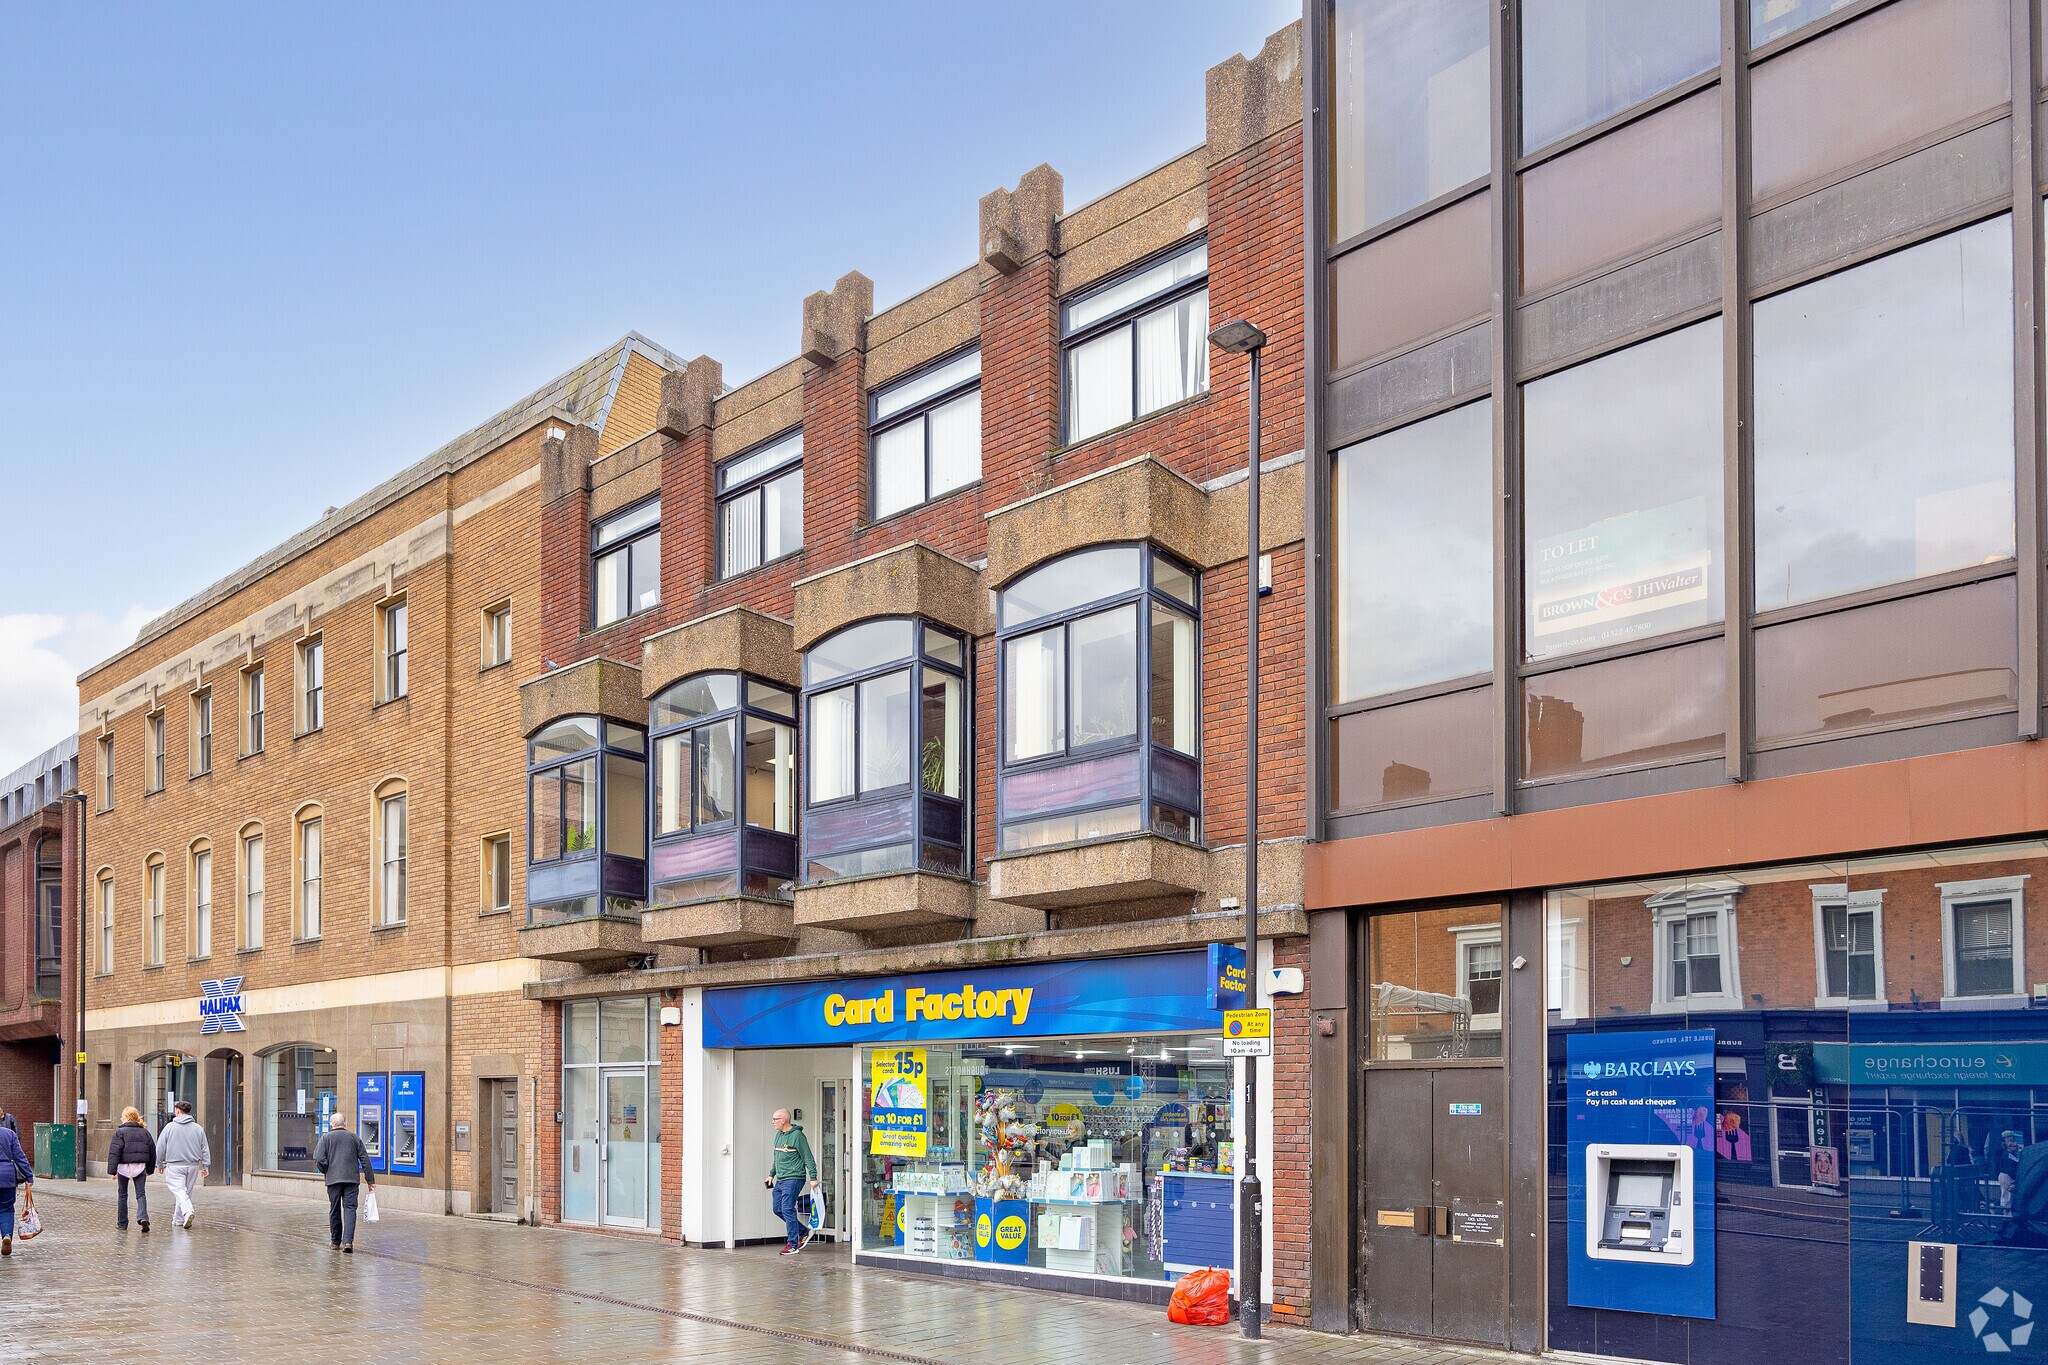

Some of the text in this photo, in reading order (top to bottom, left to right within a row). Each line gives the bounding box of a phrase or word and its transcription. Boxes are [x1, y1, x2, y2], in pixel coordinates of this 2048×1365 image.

[1541, 535, 1599, 562] TO LET
[1545, 635, 1596, 652] brown-co.com
[1220, 964, 1247, 993] Card Factor
[199, 995, 242, 1016] HALIFAX
[824, 984, 1034, 1027] Card Factory
[894, 1051, 924, 1078] 15p
[1604, 1060, 1696, 1077] BARCLAYS
[1586, 1099, 1600, 1107] Pay
[1645, 1099, 1676, 1107] cheques
[874, 1112, 923, 1126] OR 10 FOR £1
[1051, 1113, 1060, 1121] 10
[1071, 1113, 1079, 1121] £1
[882, 1132, 897, 1140] Great
[978, 1223, 989, 1231] GREAT
[978, 1230, 989, 1238] VALUE
[1000, 1225, 1022, 1233] GREAT
[1000, 1232, 1022, 1240] VALUE
